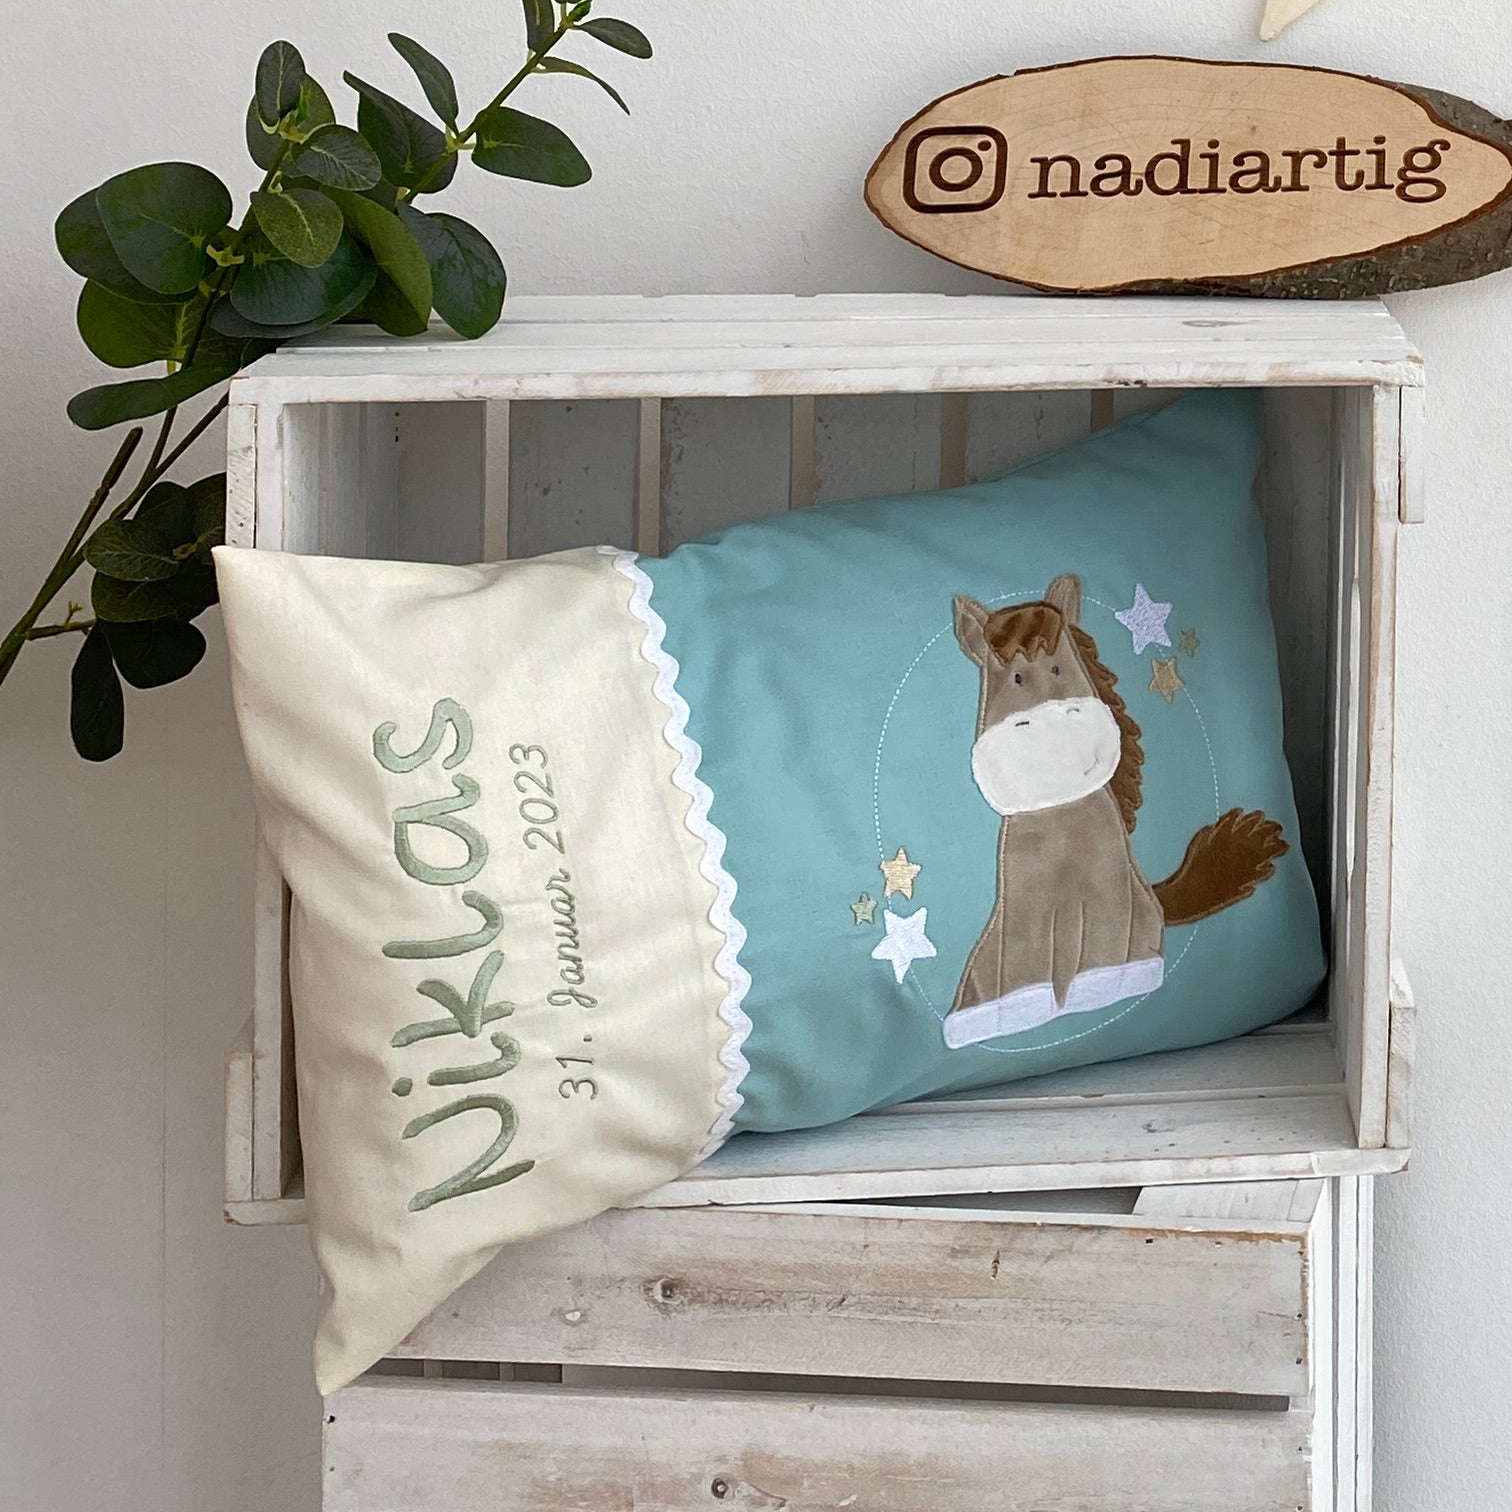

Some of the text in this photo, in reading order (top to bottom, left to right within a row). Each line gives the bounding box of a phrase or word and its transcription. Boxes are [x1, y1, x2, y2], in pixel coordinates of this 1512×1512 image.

[1027, 135, 1452, 204] nadiartig
[373, 697, 536, 1213] Niklas
[508, 742, 600, 1102] 31. Januar 2023
